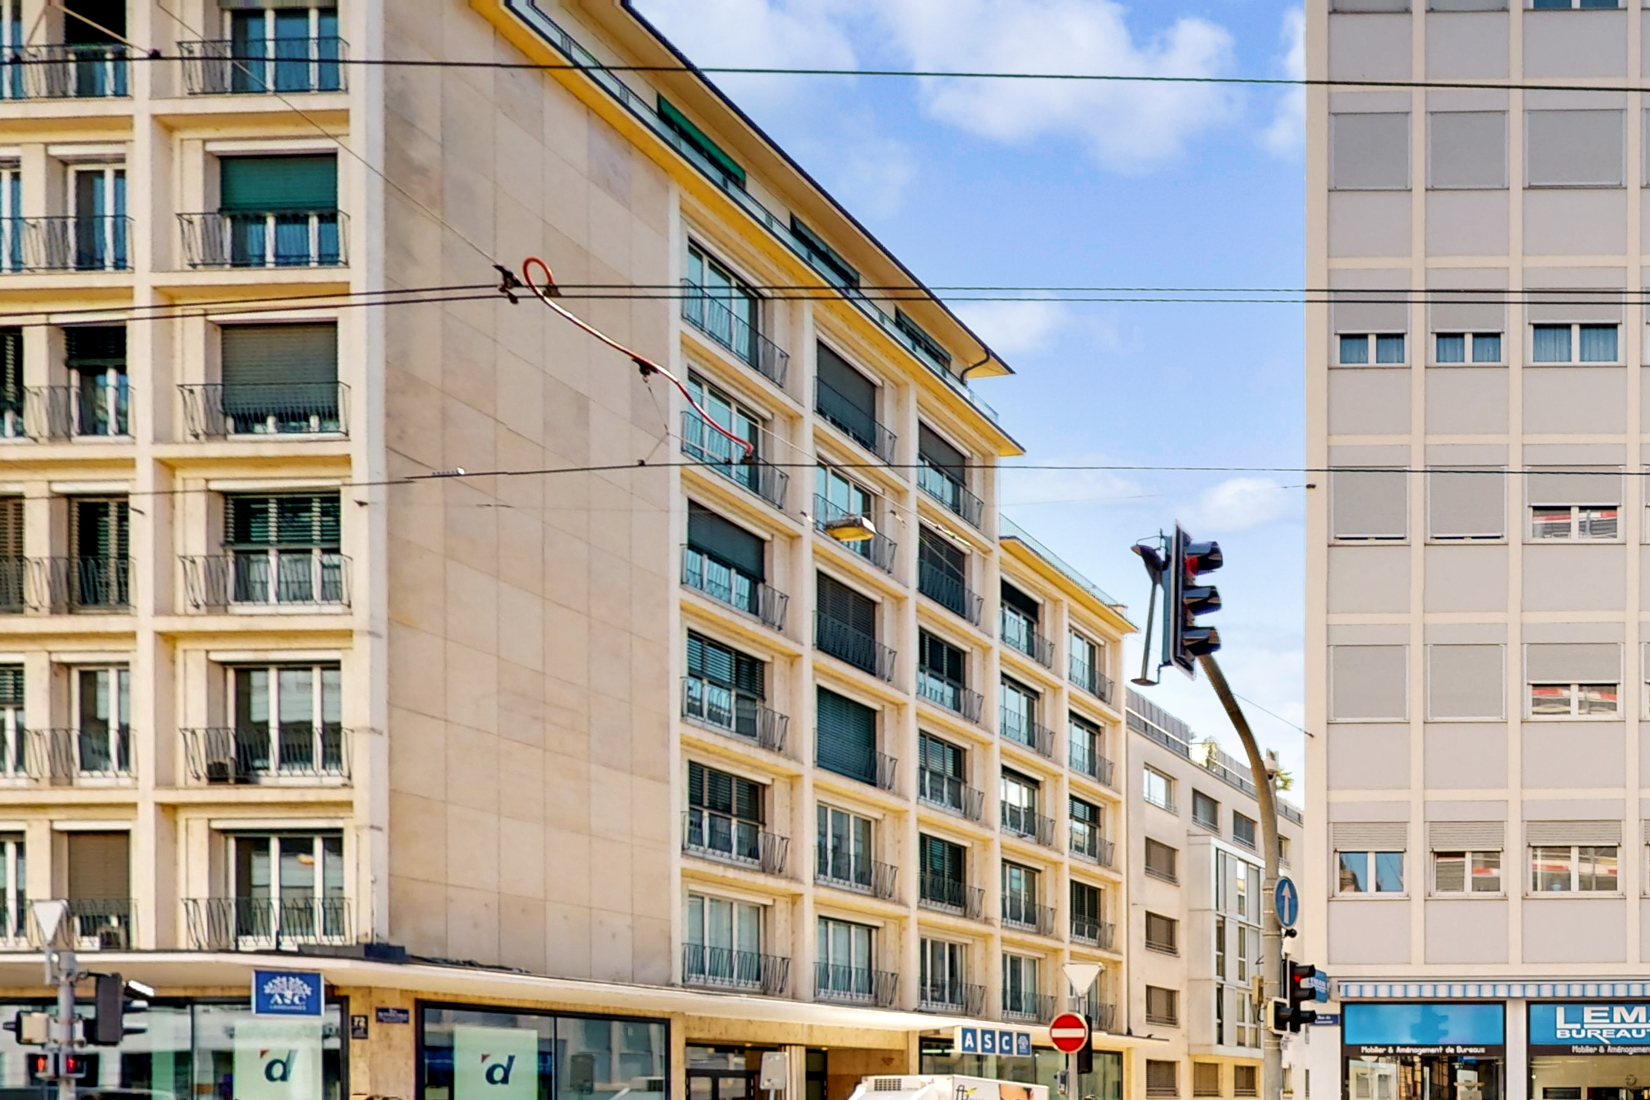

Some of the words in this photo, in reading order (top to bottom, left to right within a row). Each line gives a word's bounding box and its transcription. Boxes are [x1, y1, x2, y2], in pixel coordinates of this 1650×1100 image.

[1361, 1046, 1385, 1054] Mobilier
[1388, 1046, 1394, 1054] &
[1396, 1045, 1443, 1056] Aménagement
[1445, 1046, 1455, 1054] de
[1456, 1046, 1486, 1054] Bureaux
[1572, 1045, 1598, 1054] Mobilier
[1599, 1045, 1605, 1054] &
